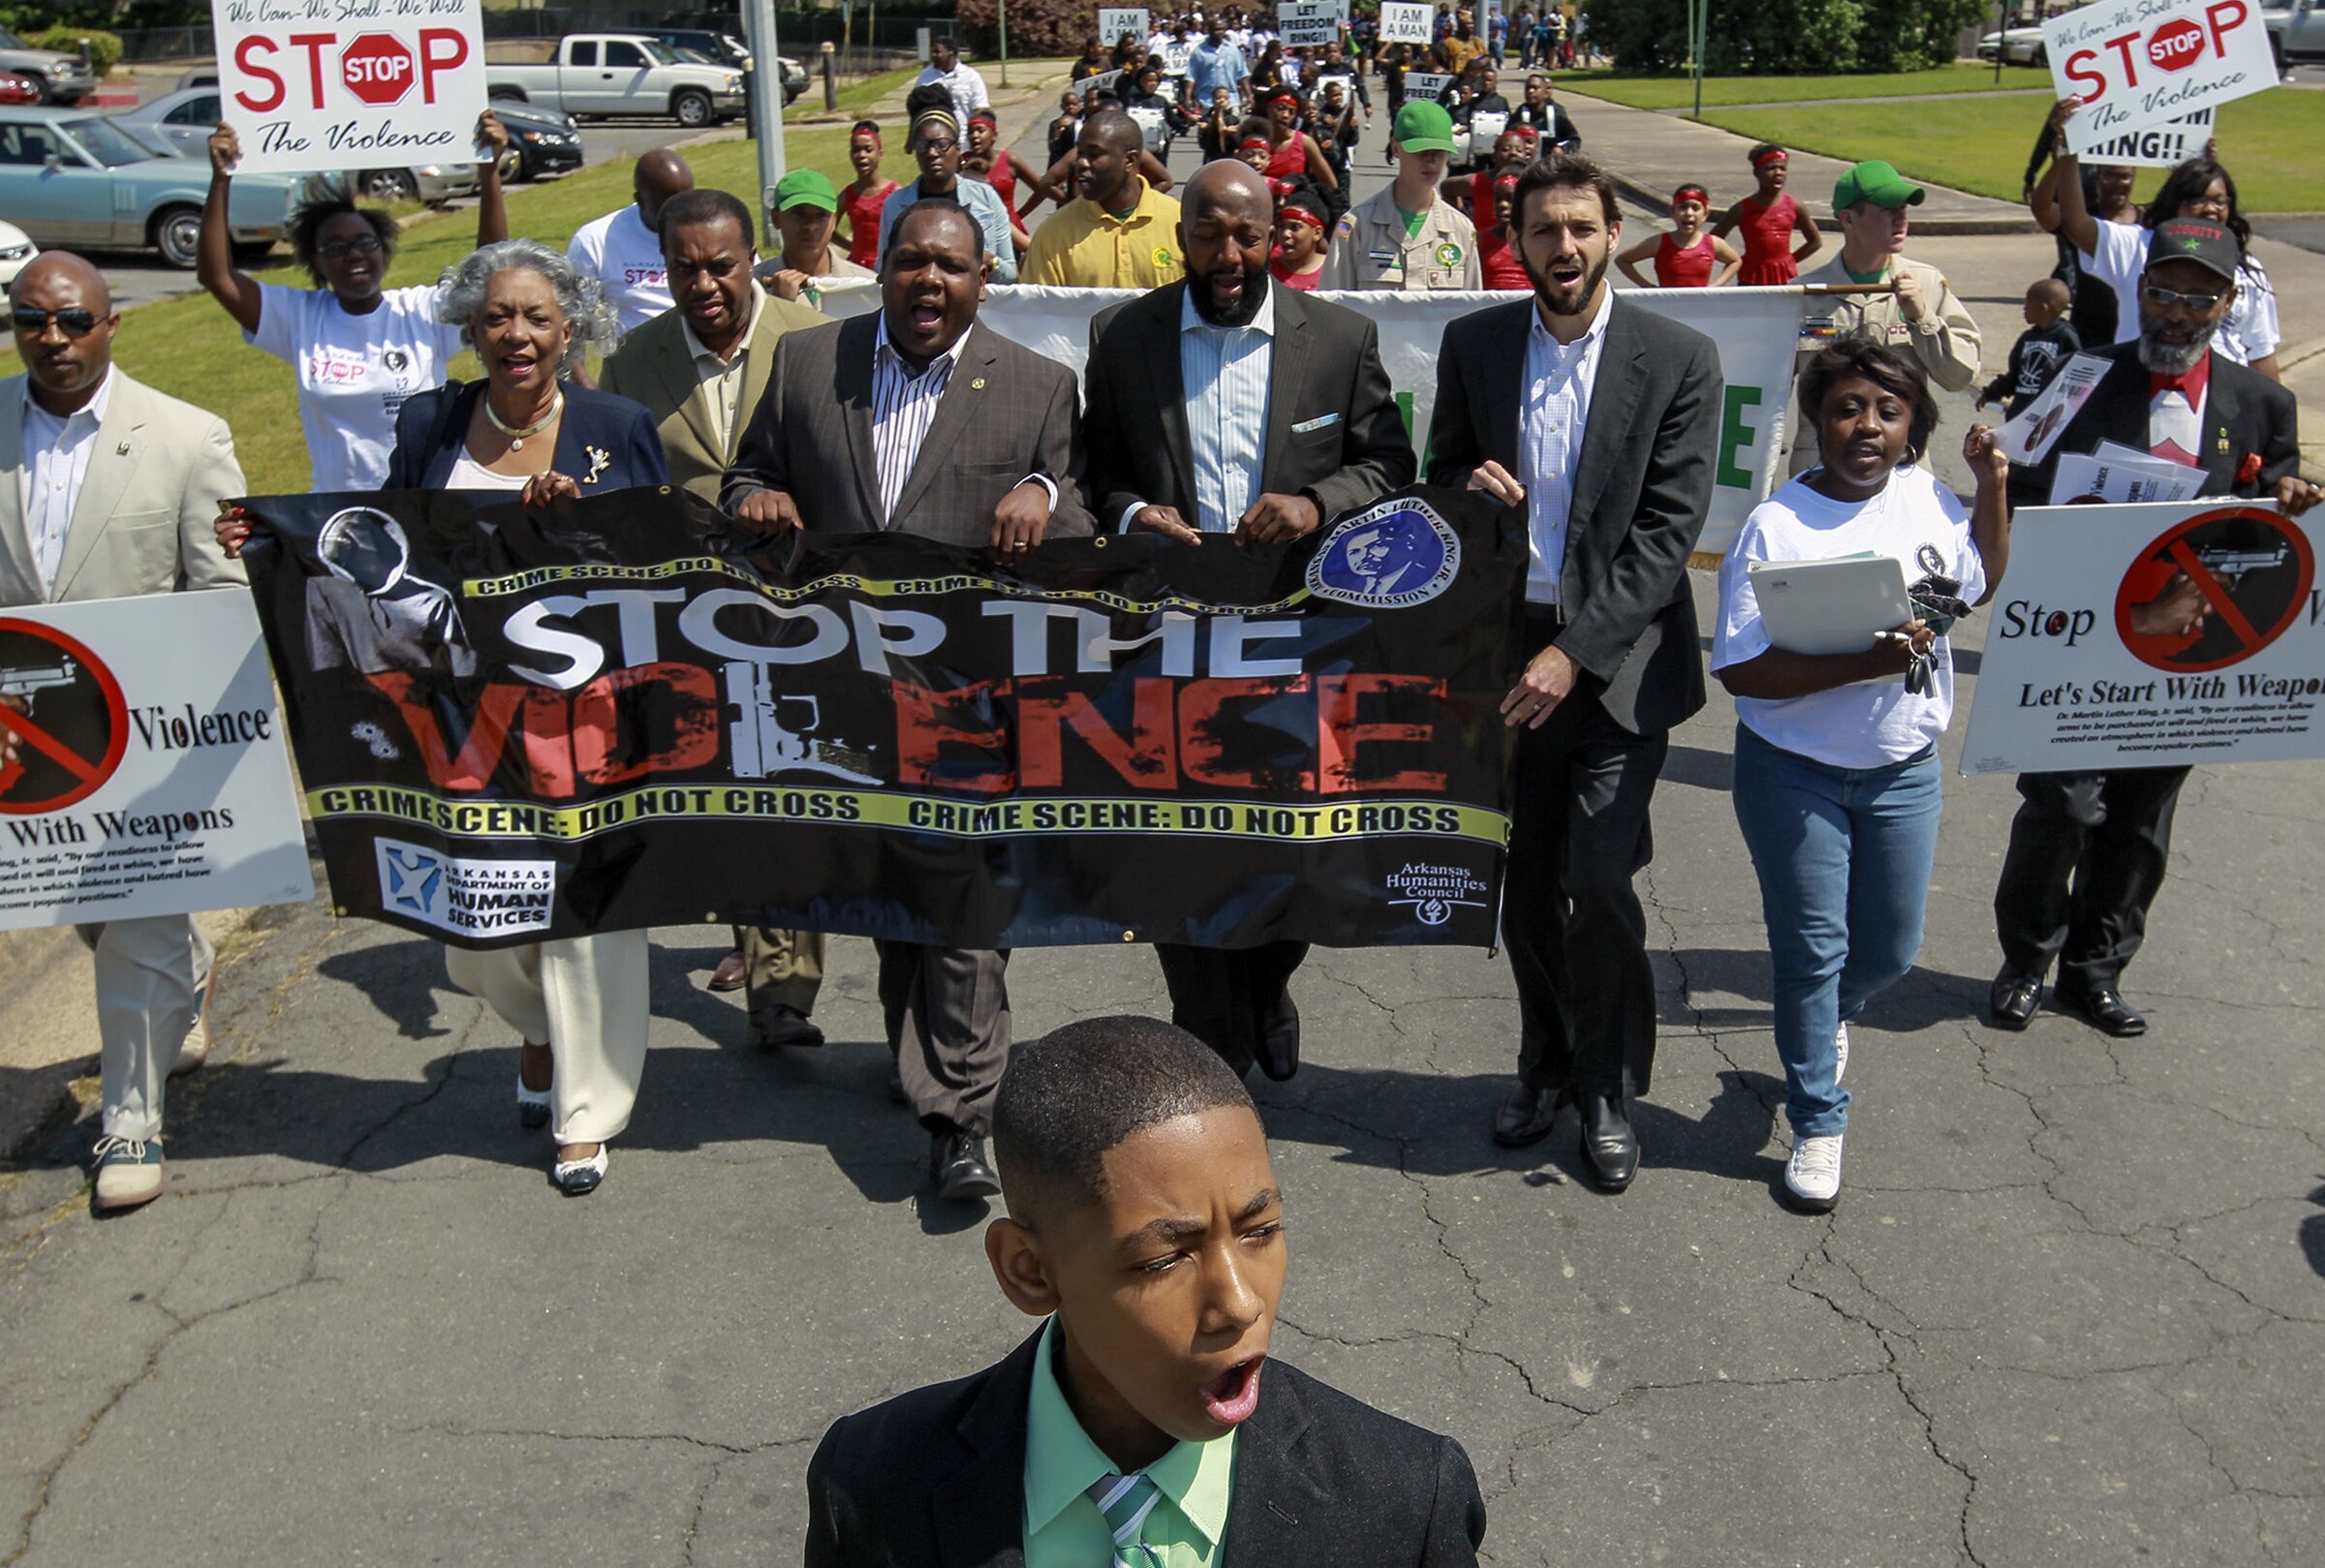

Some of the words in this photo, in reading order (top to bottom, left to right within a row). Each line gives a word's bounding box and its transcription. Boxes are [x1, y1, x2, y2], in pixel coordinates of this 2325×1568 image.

[1117, 14, 1137, 27] AM
[1297, 5, 1318, 16] LET
[1400, 9, 1423, 21] AM
[1281, 17, 1335, 30] FREEDOM
[1399, 24, 1427, 37] MAN
[2151, 29, 2202, 61] STOP
[345, 55, 410, 82] STOP
[1406, 88, 1439, 99] FREED
[1421, 77, 1441, 88] LET
[2089, 103, 2131, 131] The
[2141, 71, 2246, 113] Violence
[257, 121, 311, 154] The
[325, 120, 456, 151] Violence
[1442, 533, 1455, 563] KING
[477, 568, 563, 595] CRIME
[893, 576, 984, 595] CRIME
[1328, 587, 1430, 604] COMMISSION
[2000, 600, 2095, 647] Stop
[504, 588, 946, 689] STOP
[981, 600, 1303, 677] THE
[2018, 681, 2082, 707] Let's
[2089, 679, 2156, 704] Start
[2165, 675, 2226, 700] With
[2236, 673, 2325, 702] Weapo
[127, 703, 272, 752] Violence
[321, 789, 432, 822] CRIME
[437, 804, 569, 836] SCENE:
[579, 800, 624, 833] DO
[636, 789, 713, 816] NOT
[725, 789, 860, 819] CROSS
[909, 801, 1022, 833] CRIME
[1033, 802, 1170, 829] SCENE:
[1181, 806, 1232, 830] DO
[1246, 809, 1320, 836] NOT
[1330, 806, 1460, 833] CROSS
[9, 815, 87, 849] With
[92, 807, 234, 841] Weapons
[446, 864, 550, 879] ARKANSAS
[1401, 862, 1471, 876] Arkansas
[532, 881, 550, 890] OF
[1387, 874, 1487, 891] Humanities
[1407, 886, 1464, 899] Council
[448, 886, 549, 910] HUMAN
[448, 907, 545, 929] SERVICES
